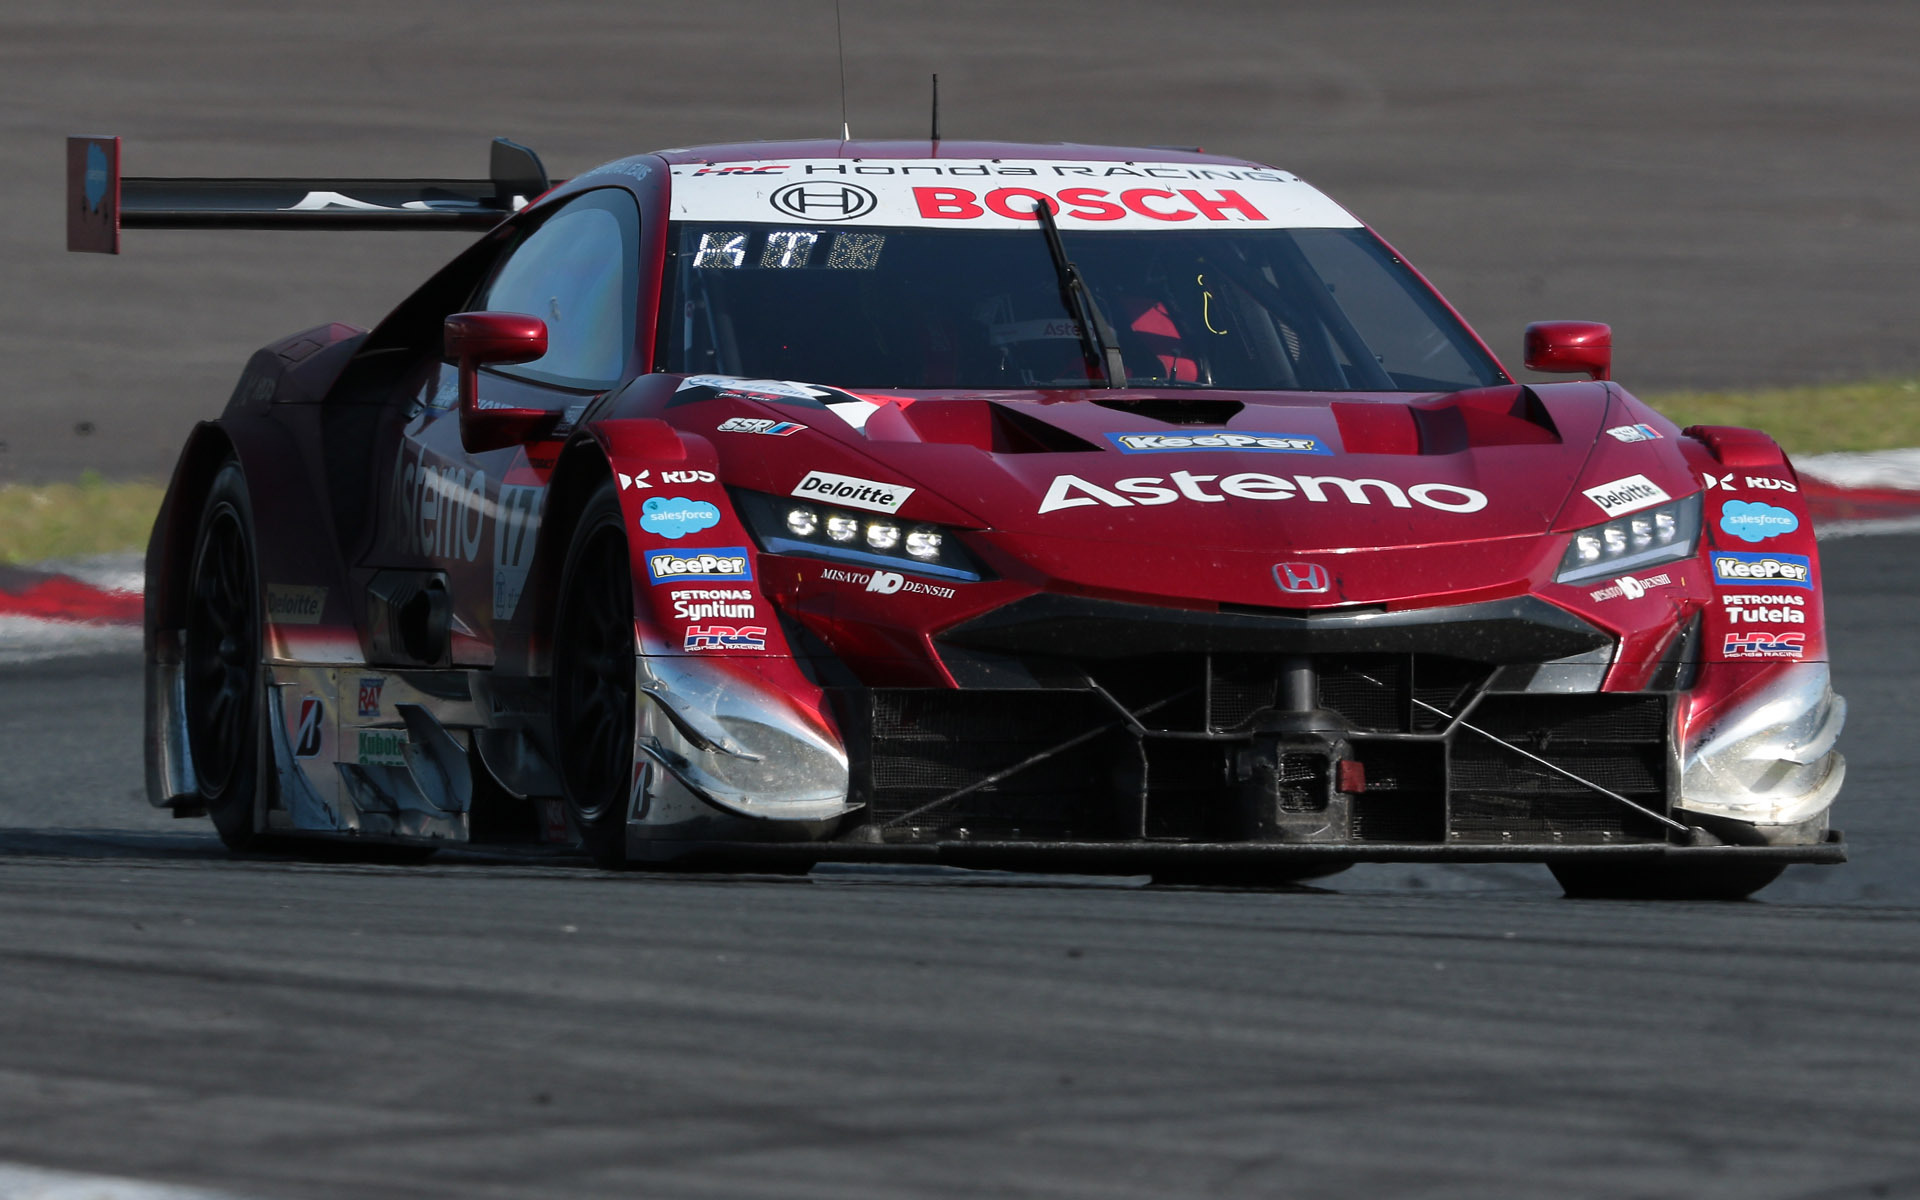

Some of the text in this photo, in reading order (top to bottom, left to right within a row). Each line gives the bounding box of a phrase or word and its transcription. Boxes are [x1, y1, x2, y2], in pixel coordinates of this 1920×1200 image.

[692, 164, 1286, 183] HRC Honda RACING
[911, 186, 1270, 222] BOSCH
[1121, 433, 1315, 452] KeePer
[382, 437, 486, 563] Astemo
[1037, 470, 1489, 515] Astemo
[650, 510, 713, 522] salesforce
[1729, 514, 1793, 526] salesforce
[501, 487, 536, 567] 17
[651, 555, 745, 577] KeePer
[1716, 558, 1806, 581] KeePer
[820, 568, 870, 585] MISATO
[902, 580, 956, 599] DENSHI
[670, 589, 752, 601] PETRONAS
[1722, 594, 1805, 606] PETRONAS
[673, 601, 755, 621] Syntium
[1725, 606, 1805, 625] Tutela
[684, 625, 767, 649] HRC
[1723, 632, 1806, 654] HRC
[684, 645, 725, 653] Honda
